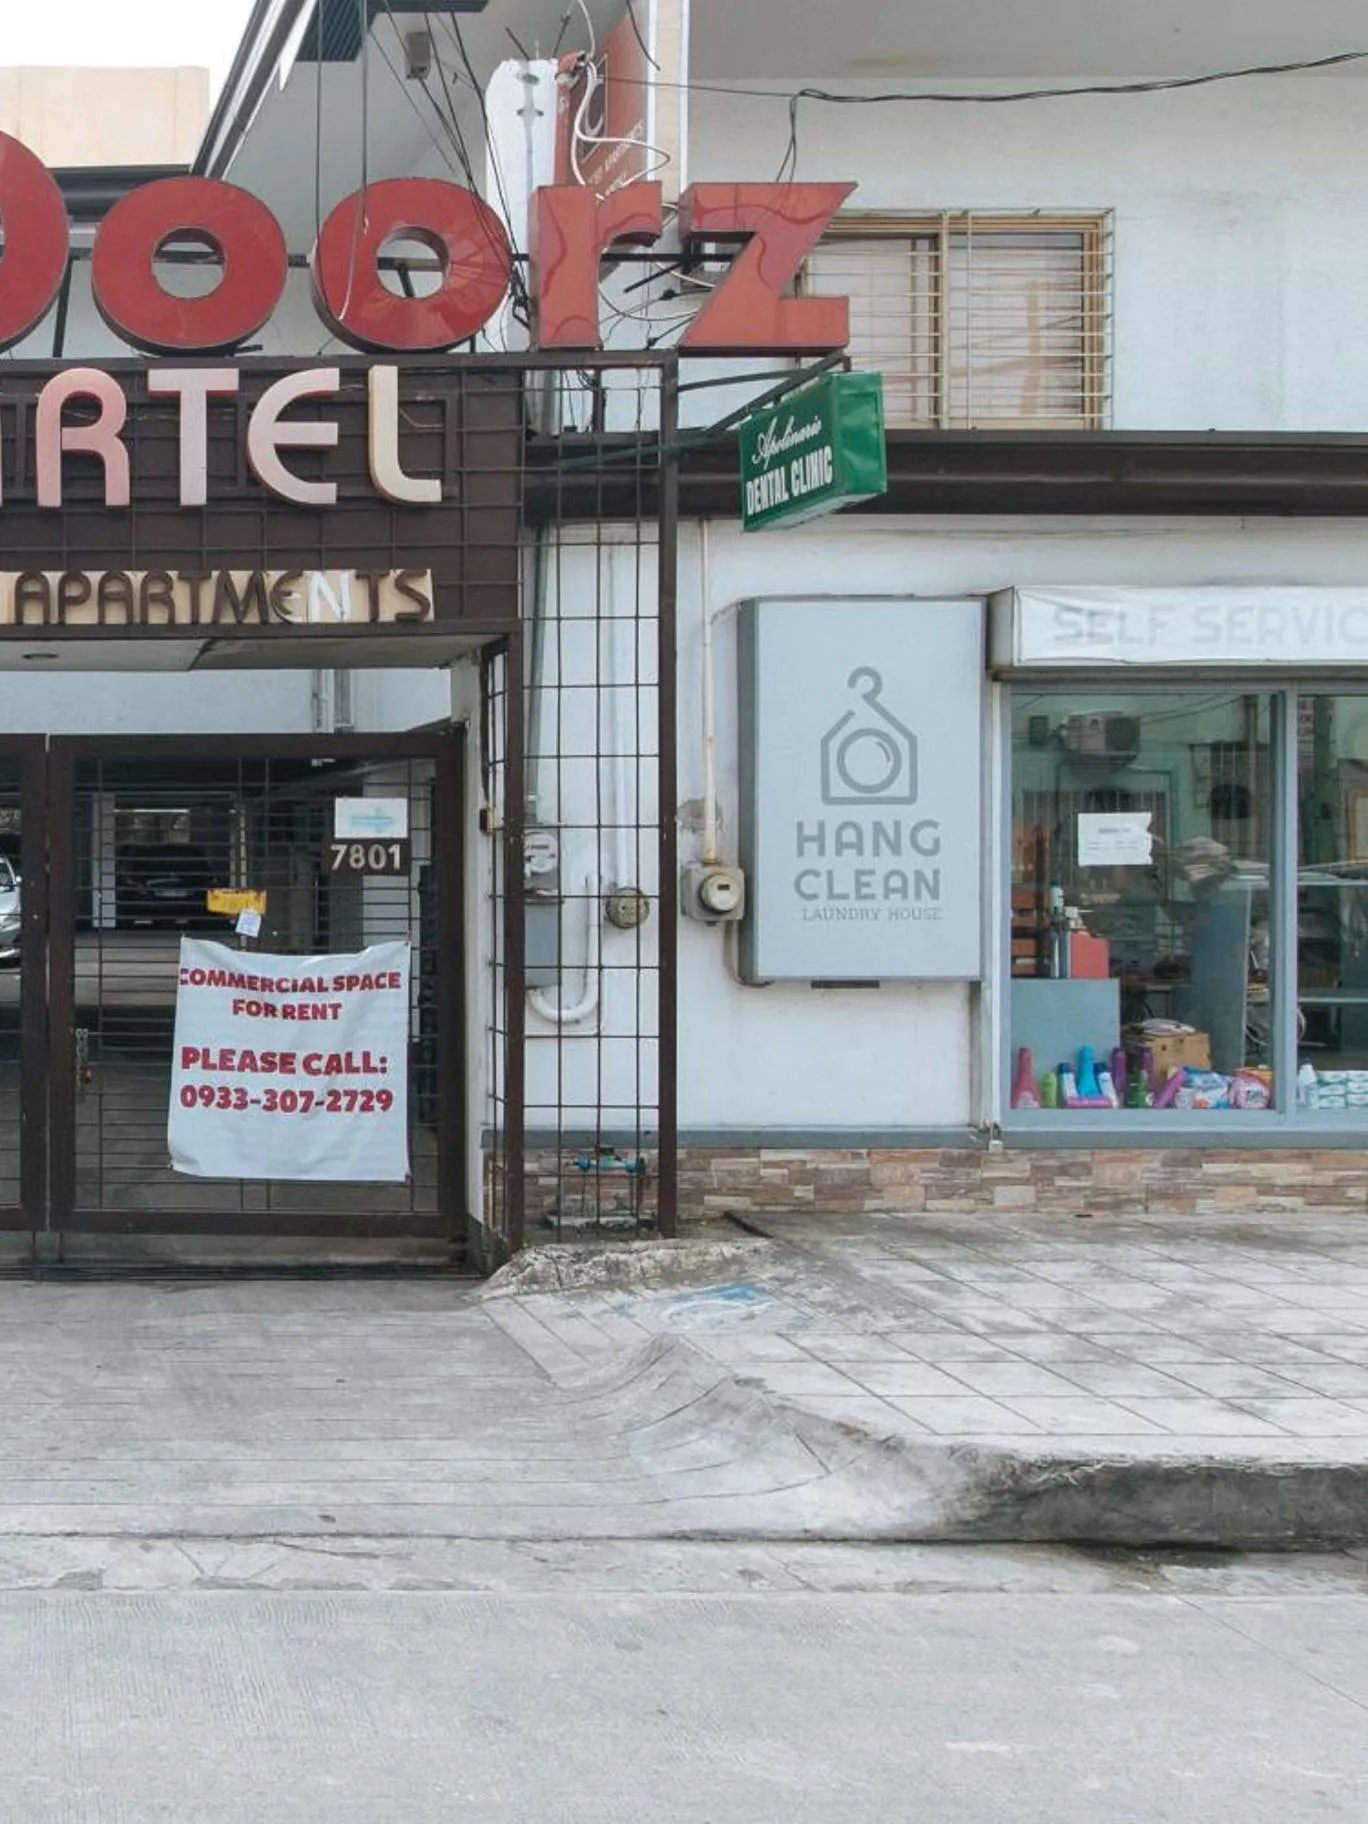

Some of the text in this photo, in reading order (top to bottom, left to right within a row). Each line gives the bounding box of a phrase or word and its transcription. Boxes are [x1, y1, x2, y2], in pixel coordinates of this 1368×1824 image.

[746, 445, 833, 516] DENTAL CLINIC
[13, 569, 432, 625] APARTMENTS
[1052, 605, 1176, 646] SELF
[796, 819, 942, 858] HANG
[330, 843, 401, 871] 7801
[794, 868, 942, 901] CLEAN
[802, 906, 943, 922] LAUNDRY HOUSE
[332, 971, 402, 993] SPACE
[232, 998, 343, 1021] FOR RENT
[181, 1046, 388, 1075] PLEASE CALL:
[180, 1084, 394, 1113] 0933-307-2729
